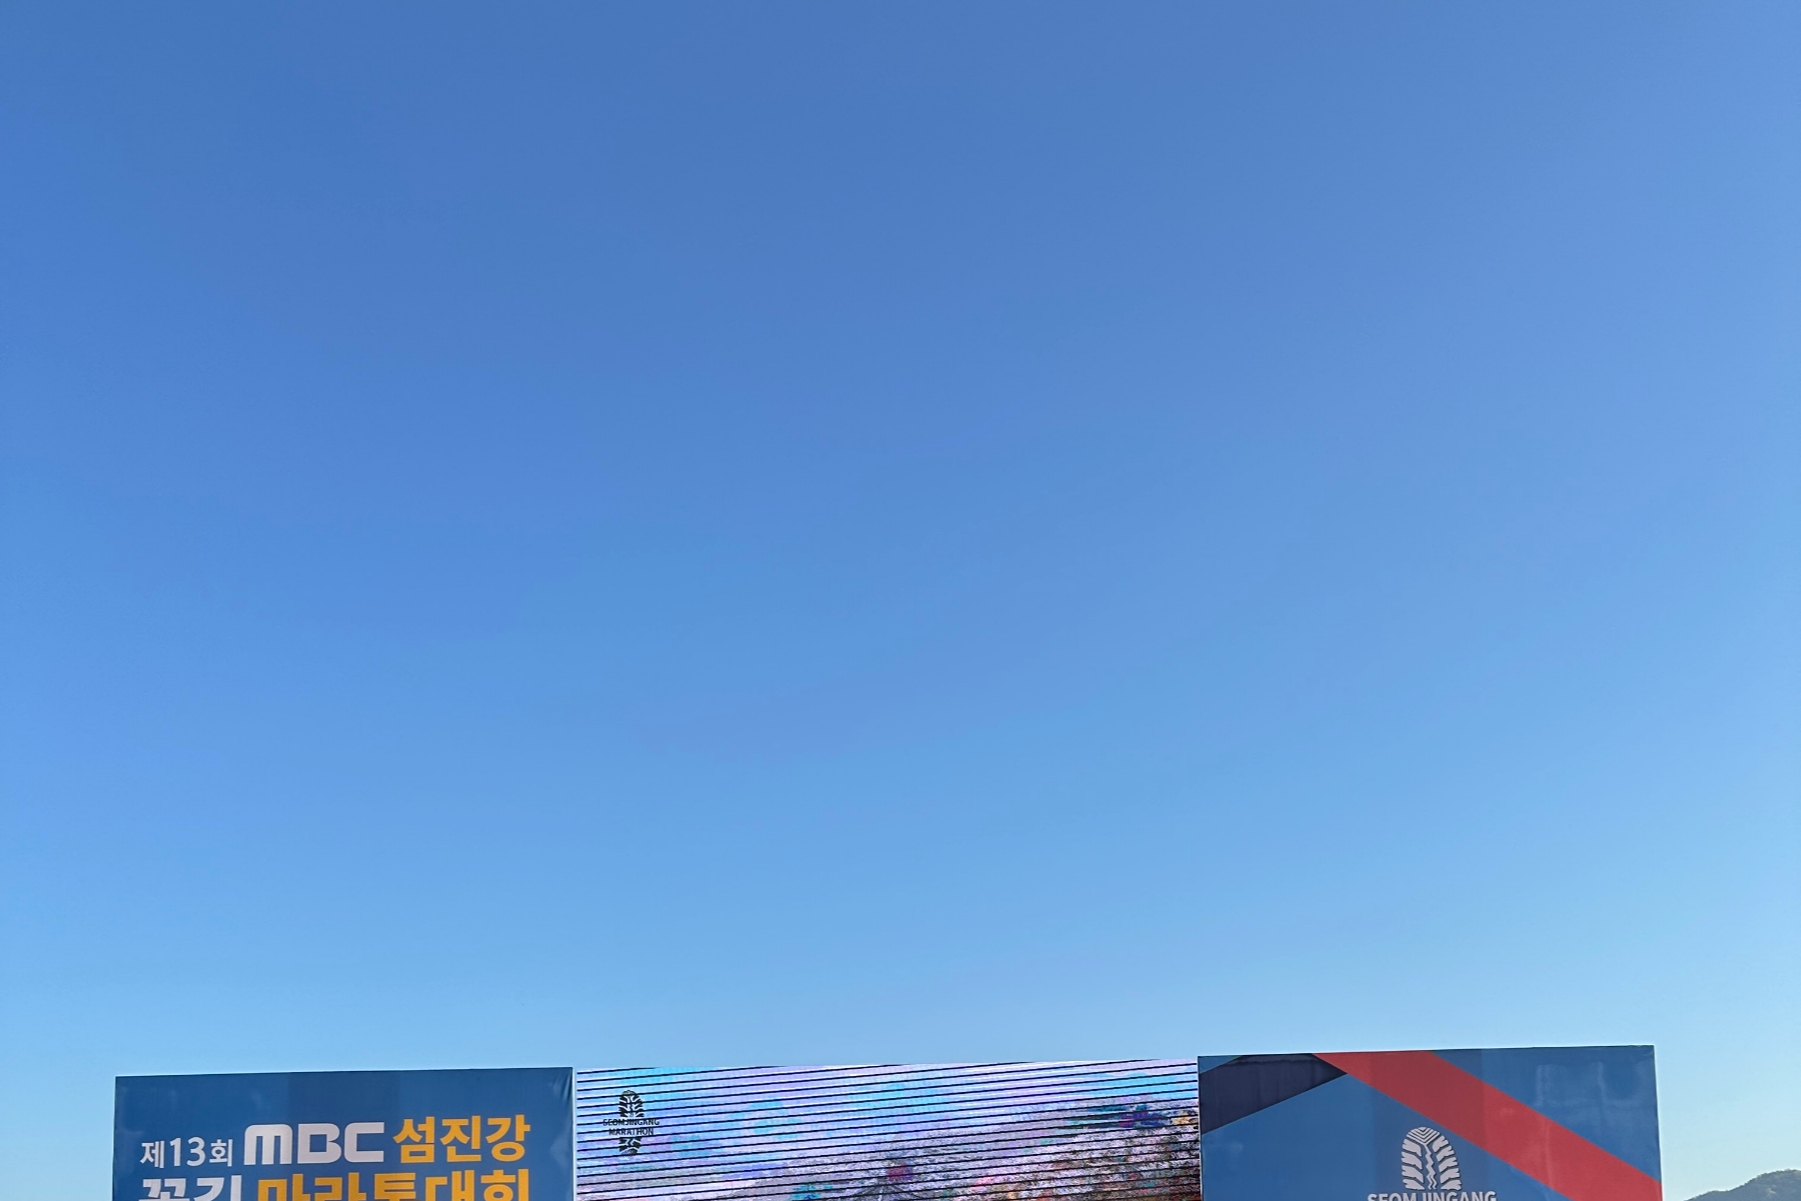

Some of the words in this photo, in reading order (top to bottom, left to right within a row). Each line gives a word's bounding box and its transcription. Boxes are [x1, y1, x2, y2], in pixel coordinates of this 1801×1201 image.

[140, 1137, 233, 1168] 제13회
[243, 1122, 385, 1166] MBC
[393, 1114, 531, 1164] 섬진강
